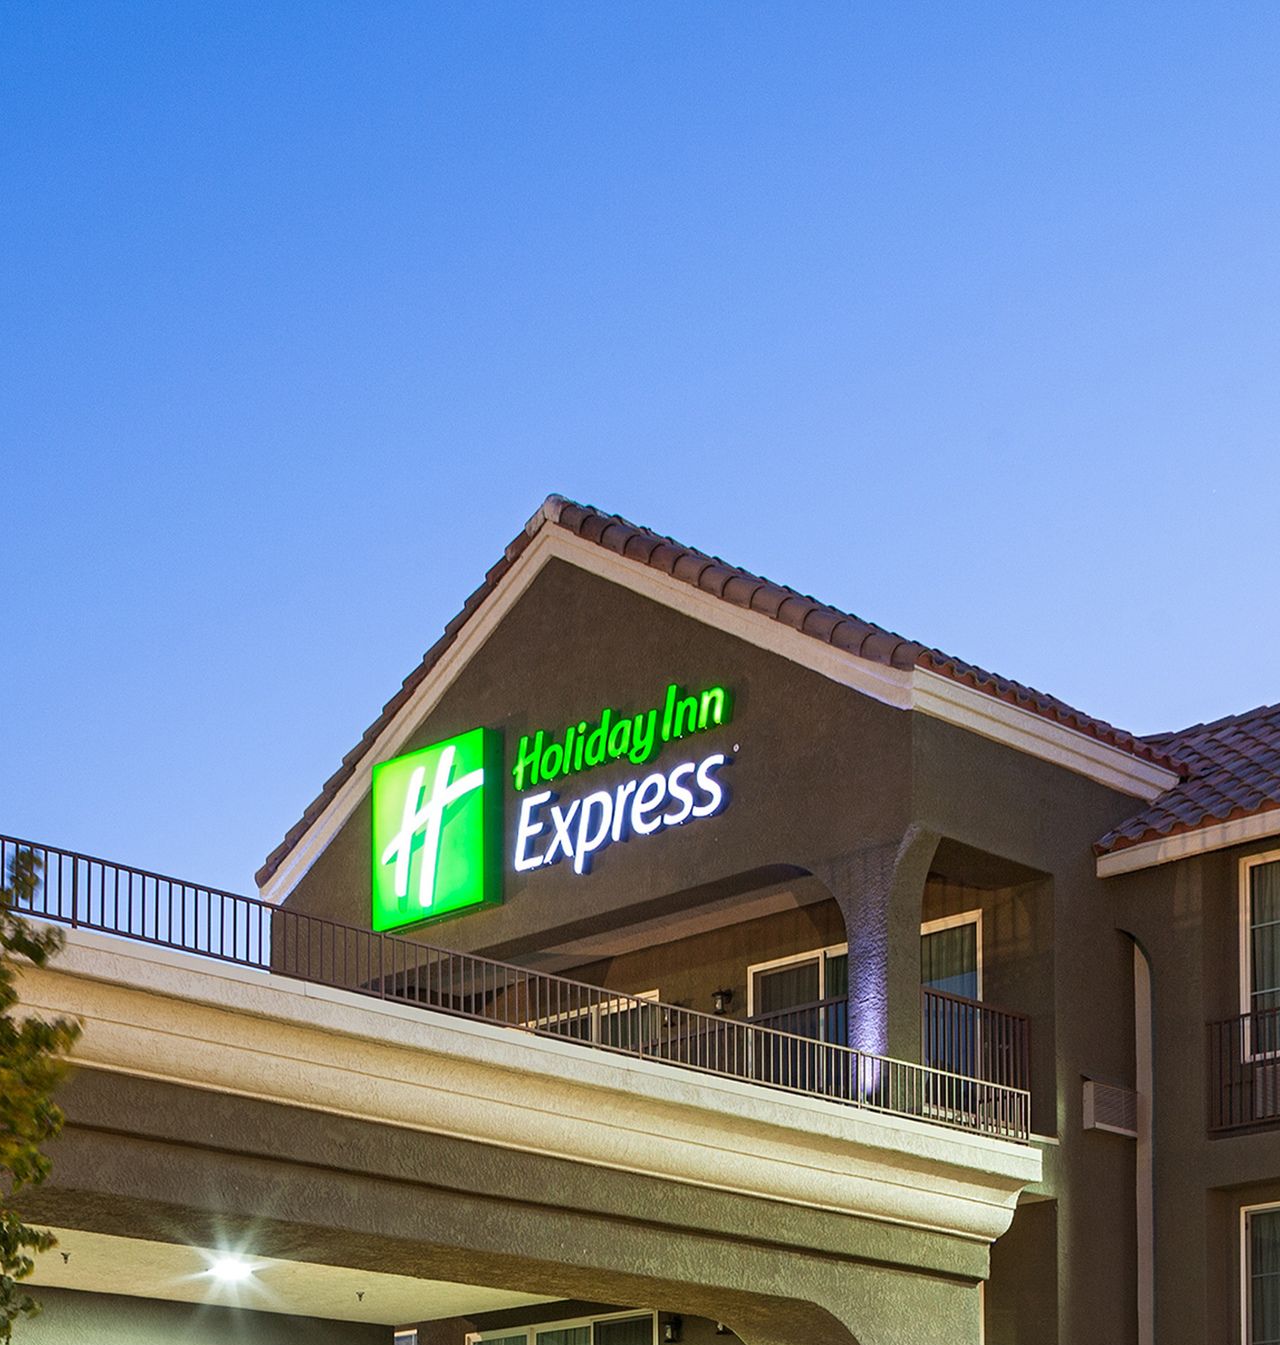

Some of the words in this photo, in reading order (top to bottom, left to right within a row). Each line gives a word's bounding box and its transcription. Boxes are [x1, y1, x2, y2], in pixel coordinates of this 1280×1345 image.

[513, 708, 659, 791] Holiday
[661, 683, 726, 741] Inn
[513, 752, 726, 875] Express
